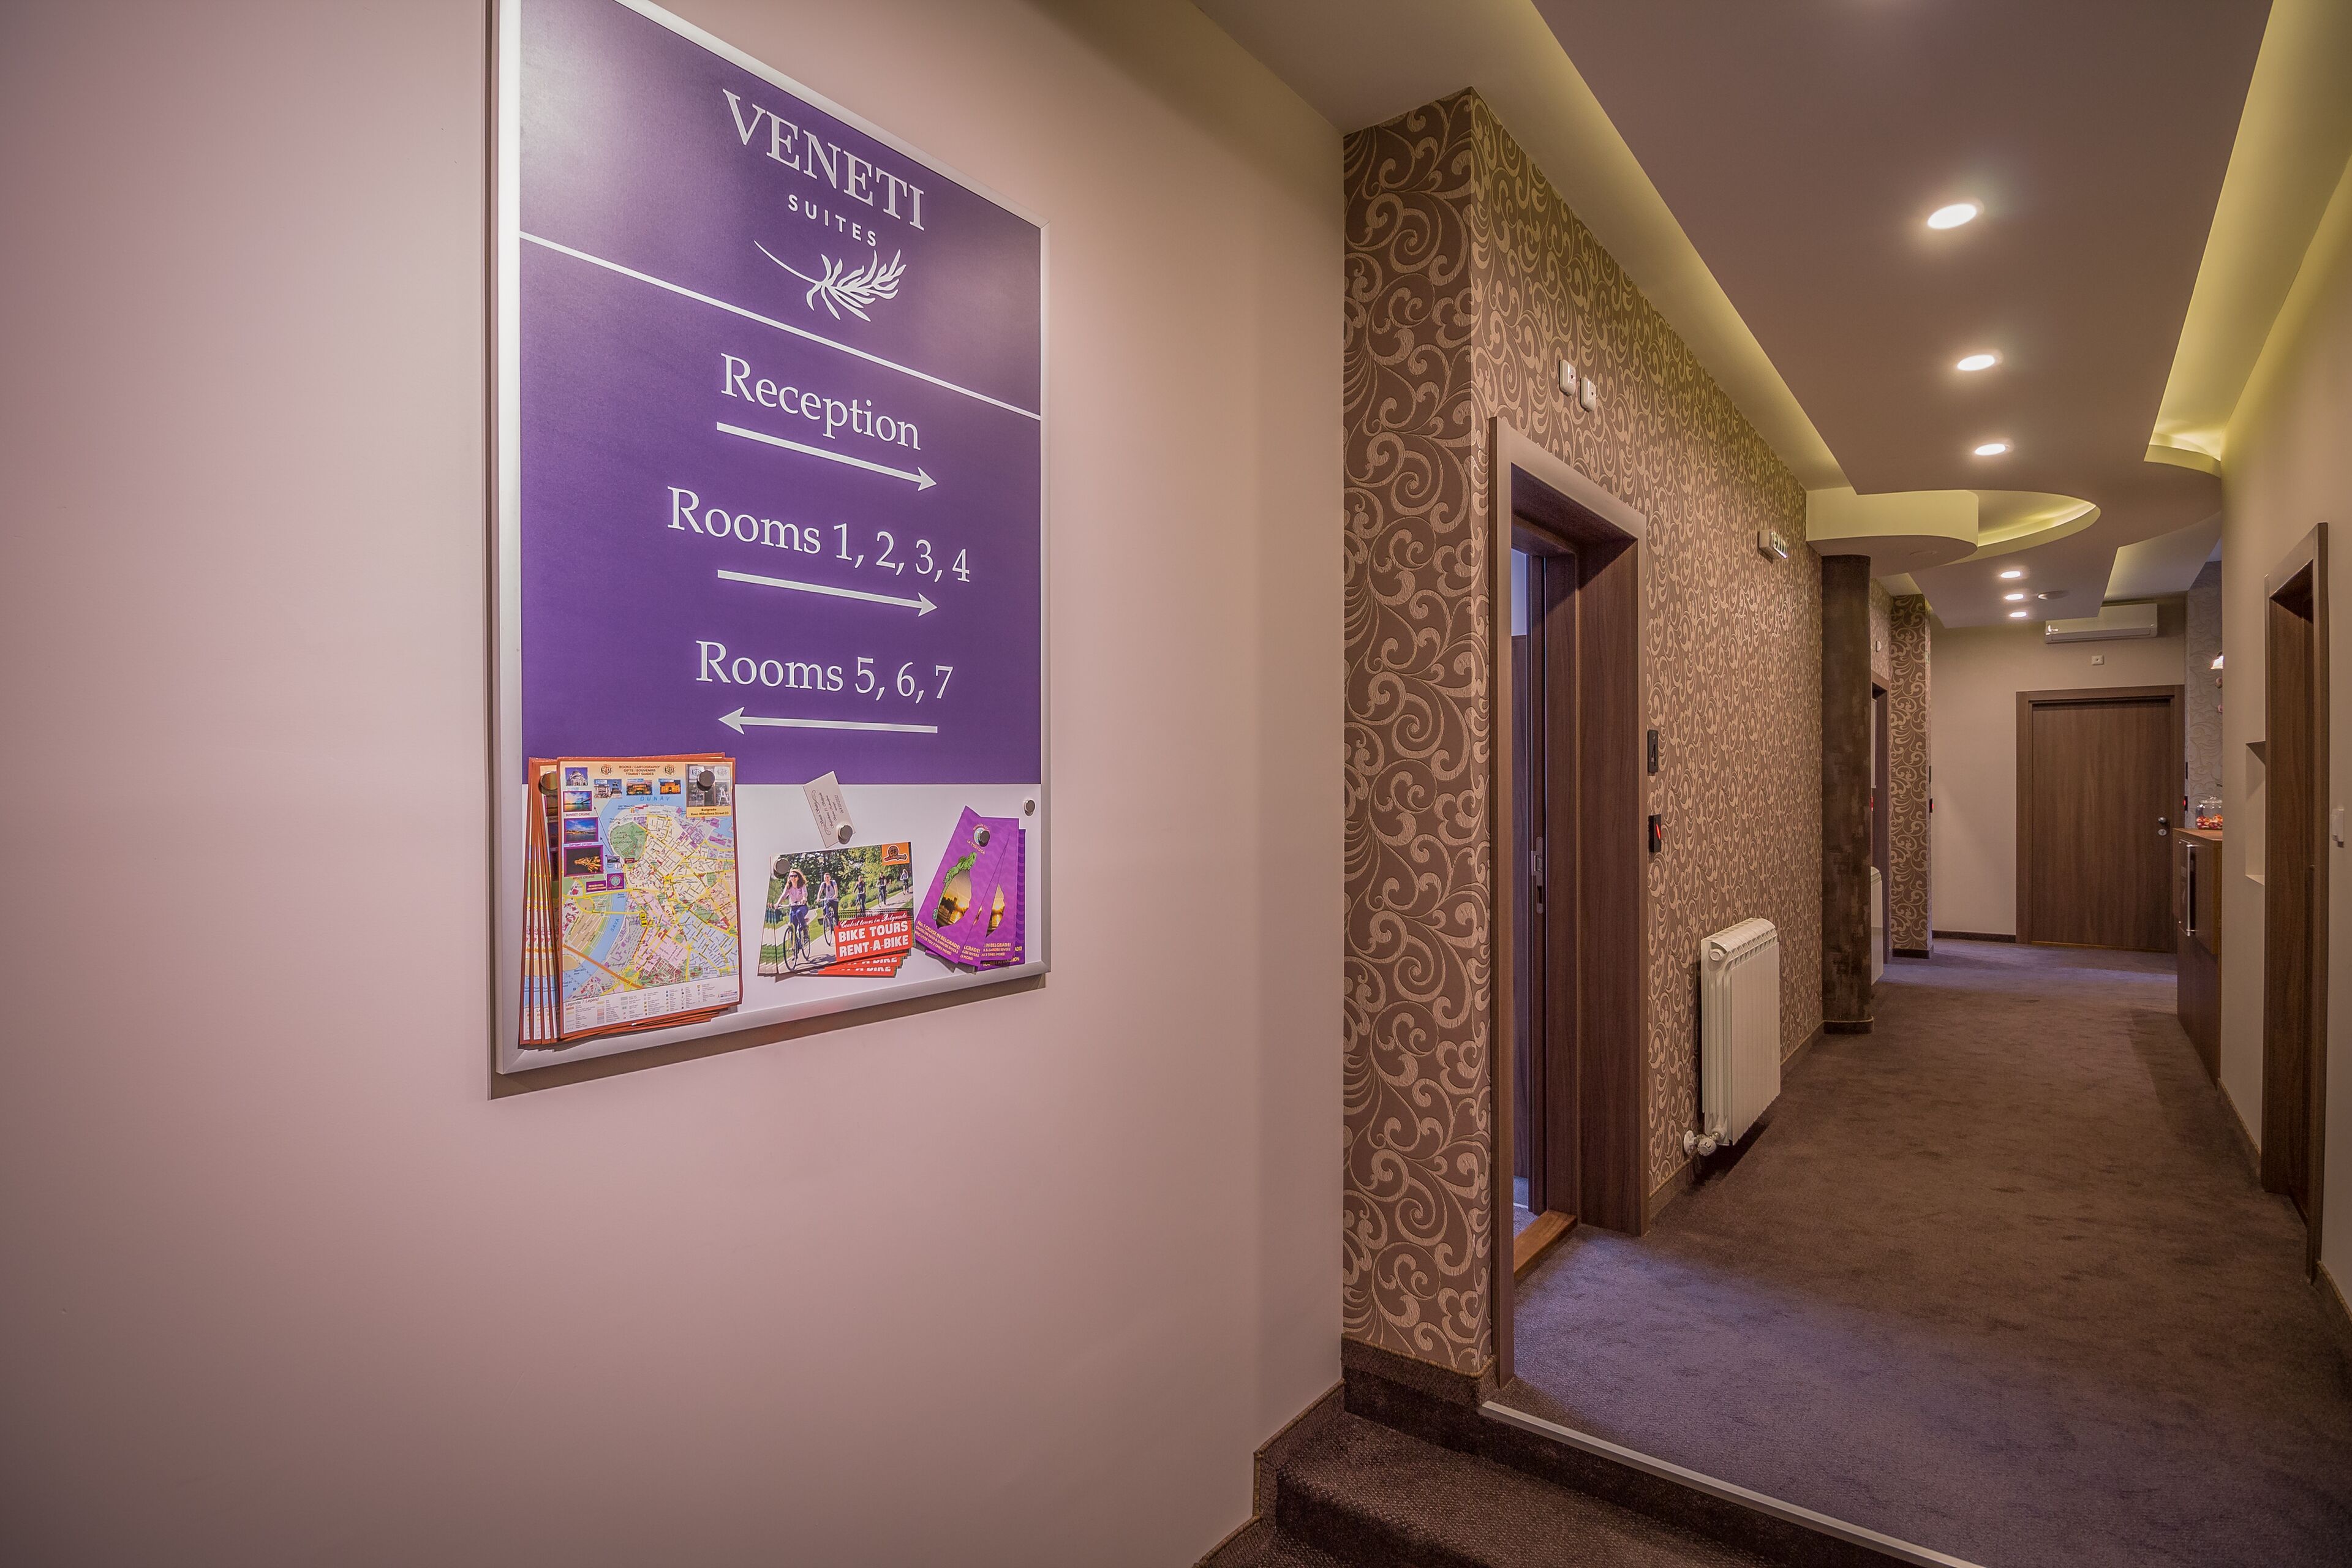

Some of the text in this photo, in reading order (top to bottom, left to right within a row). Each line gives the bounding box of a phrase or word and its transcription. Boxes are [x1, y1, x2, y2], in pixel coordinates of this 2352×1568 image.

[723, 88, 925, 232] VENETI
[788, 194, 877, 247] SUITES
[720, 352, 921, 451] Reception
[667, 485, 970, 582] Rooms 1, 2, 3, 4
[695, 639, 954, 704] Rooms 5, 6, 7
[610, 918, 619, 932] SAVA
[839, 921, 908, 943] BIKE TOURS
[881, 912, 907, 923] Belgrade
[839, 934, 909, 957] RENT-A-BIKE
